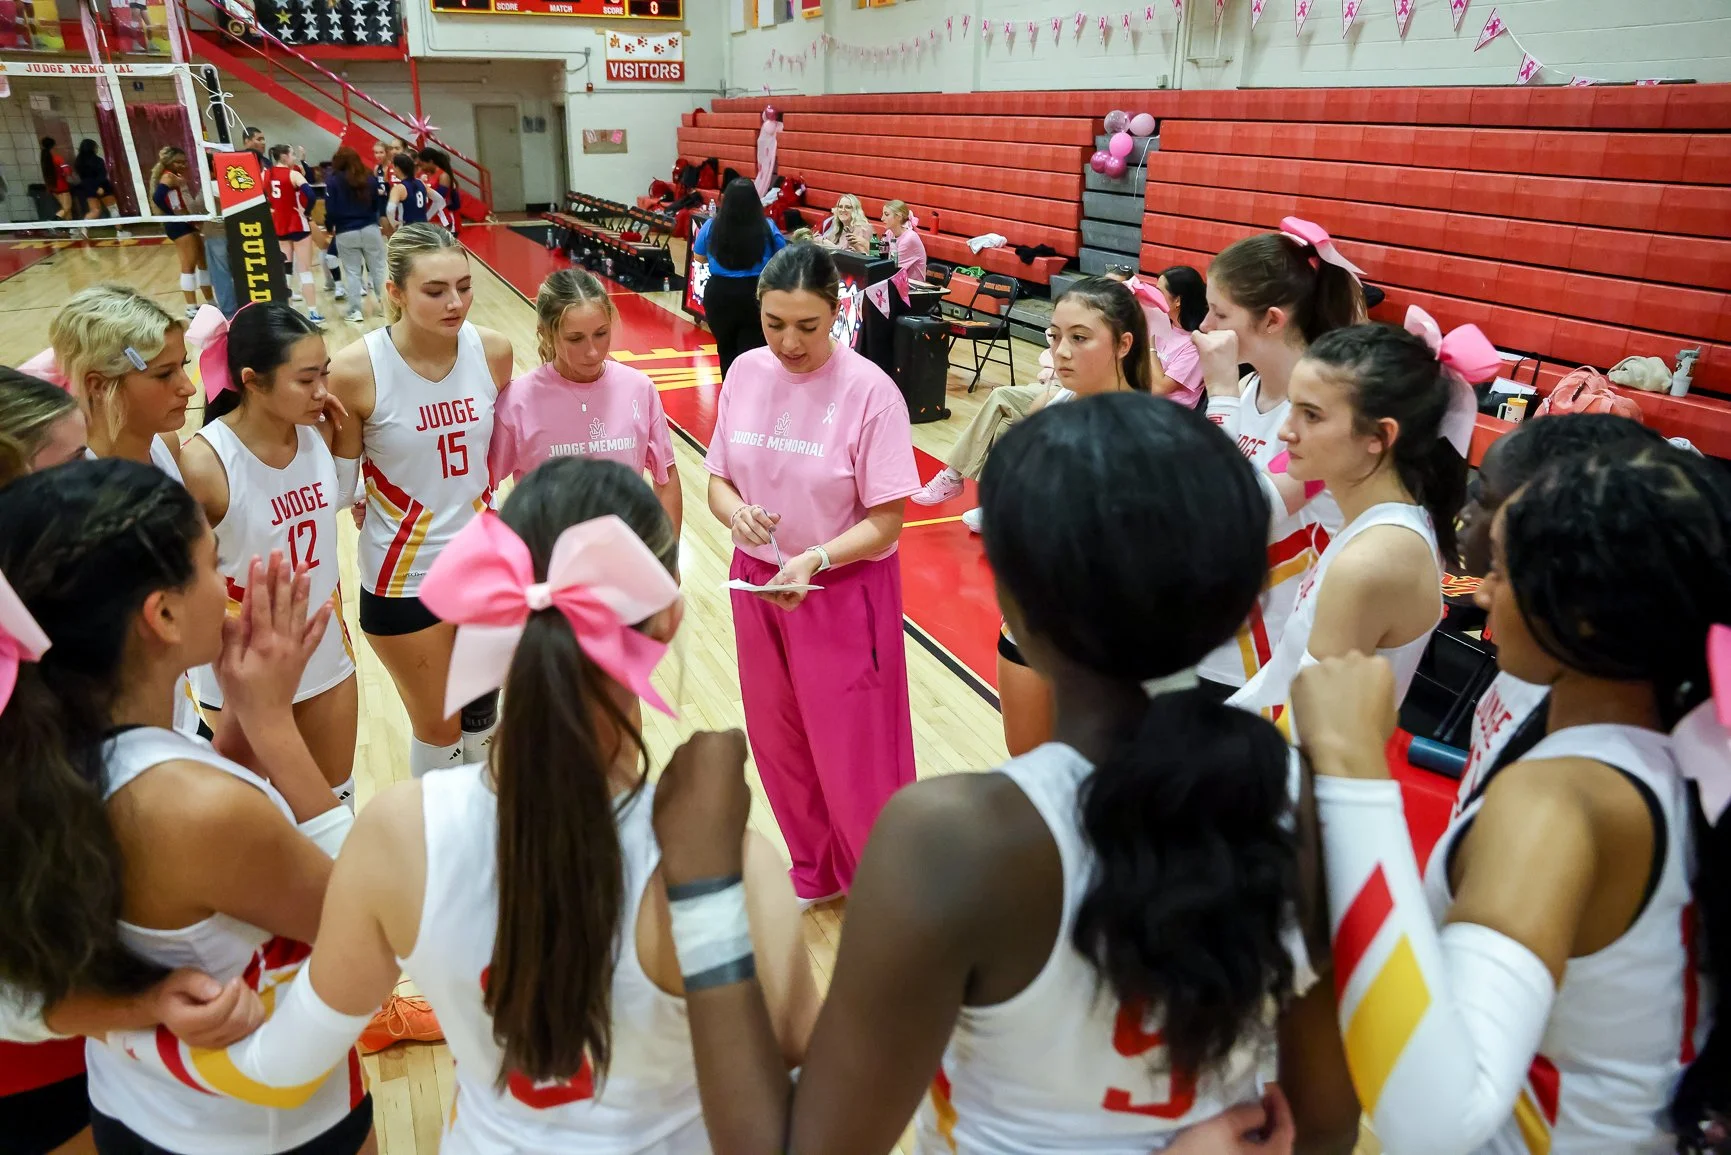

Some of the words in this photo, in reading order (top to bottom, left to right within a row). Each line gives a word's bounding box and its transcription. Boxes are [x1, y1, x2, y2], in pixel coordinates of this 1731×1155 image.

[496, 3, 519, 11] SCORE
[549, 4, 573, 13] MATCH
[602, 6, 624, 15] SCORE
[26, 63, 65, 74] JUDGE
[71, 64, 133, 74] MEMOIAL
[609, 62, 681, 79] VISITORS
[271, 180, 282, 199] 5
[415, 191, 424, 209] 8
[416, 397, 480, 431] JUDGE
[548, 442, 587, 458] JUDGE
[729, 430, 766, 447] JUDGE
[766, 435, 825, 458] MEMORIAL
[437, 430, 469, 479] 15
[270, 481, 328, 526] JUDGE
[288, 519, 320, 572] 12
